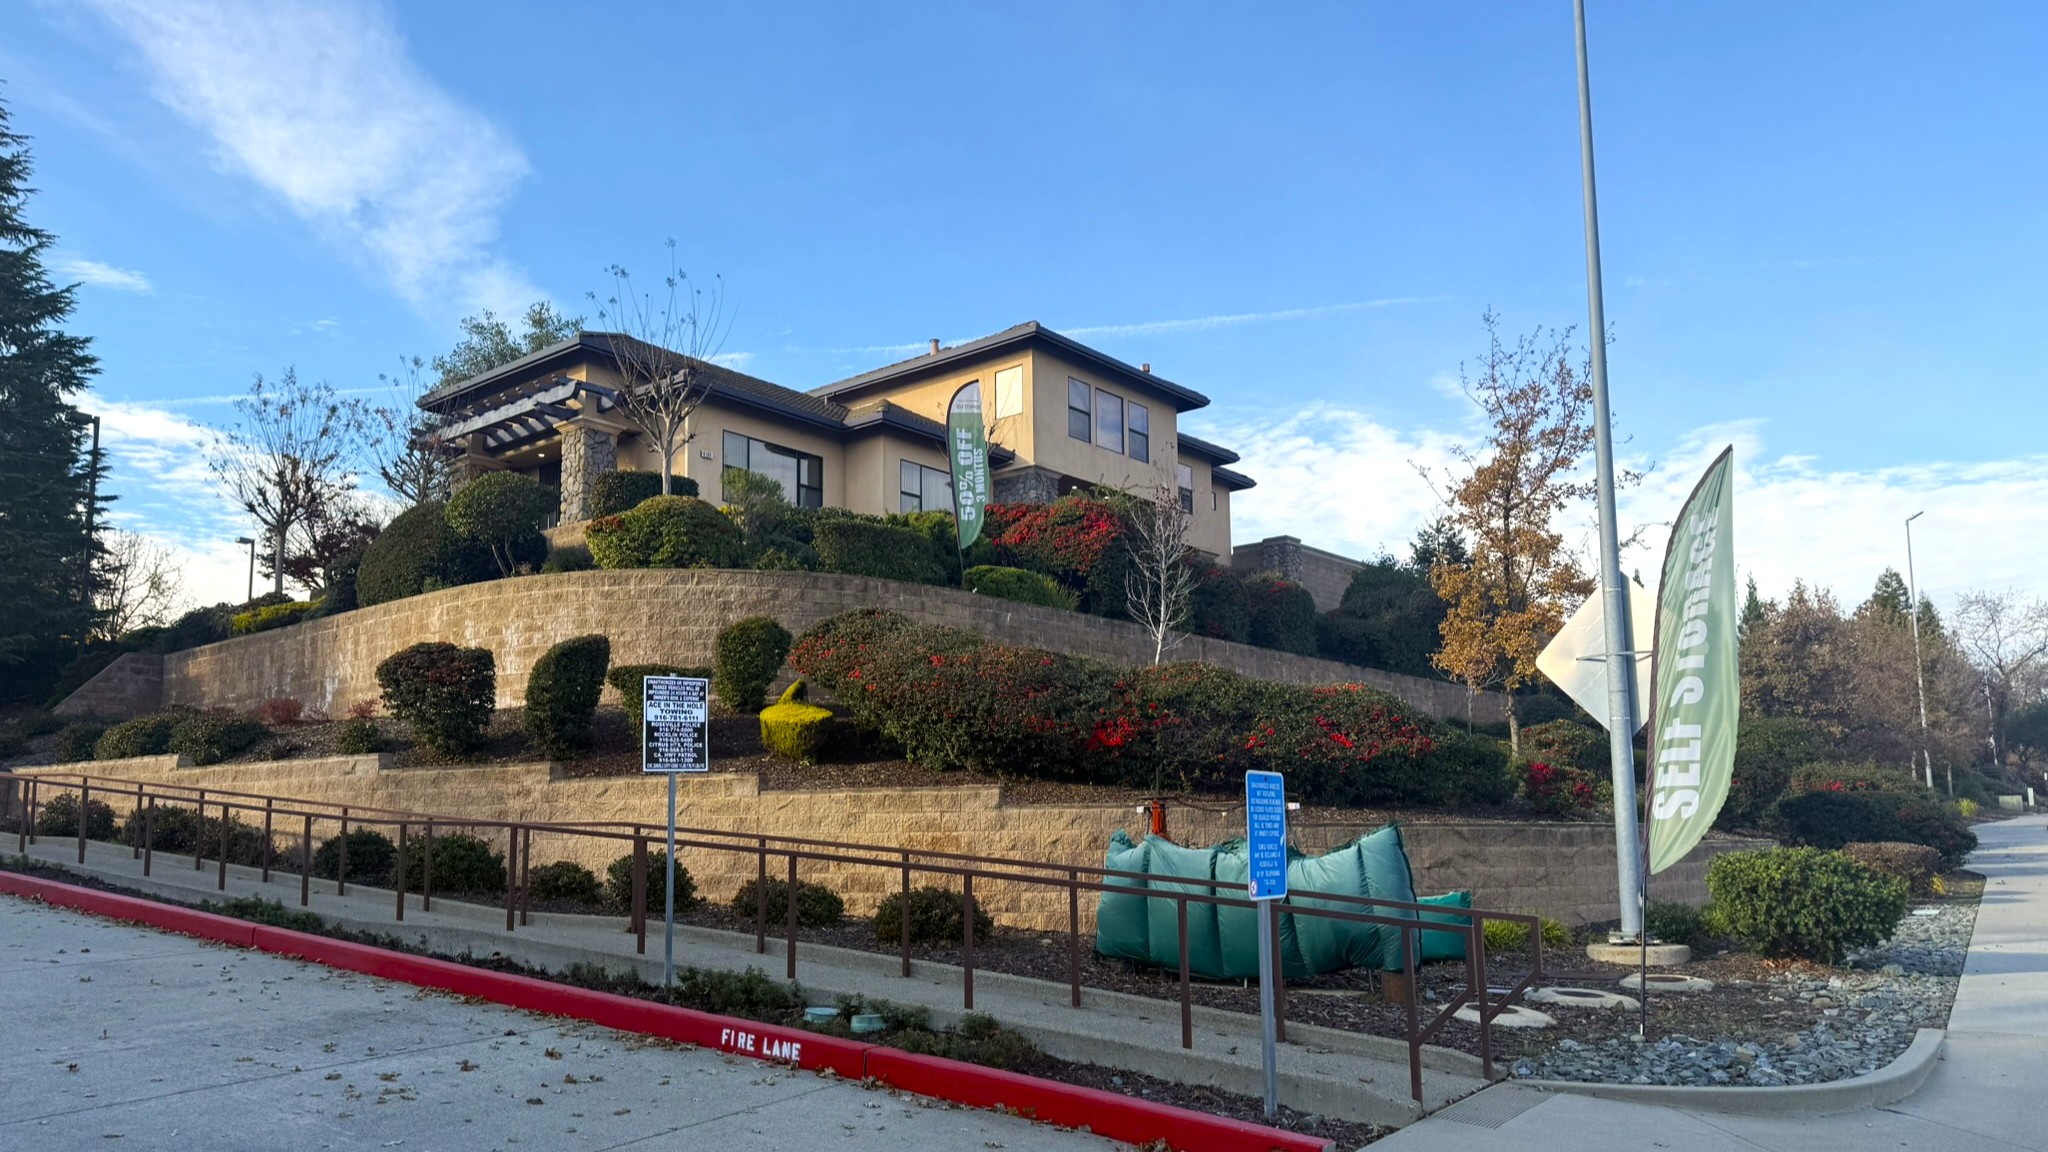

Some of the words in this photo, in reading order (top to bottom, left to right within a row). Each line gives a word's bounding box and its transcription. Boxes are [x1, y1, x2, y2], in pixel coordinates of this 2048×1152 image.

[956, 428, 974, 466] OFF
[974, 448, 985, 492] MONTHS
[959, 470, 976, 520] 50%
[976, 494, 986, 502] 3
[1670, 507, 1719, 708] STORAGE
[1653, 718, 1702, 820] SELF
[722, 1028, 755, 1052] FIRE
[763, 1037, 801, 1061] LANE
